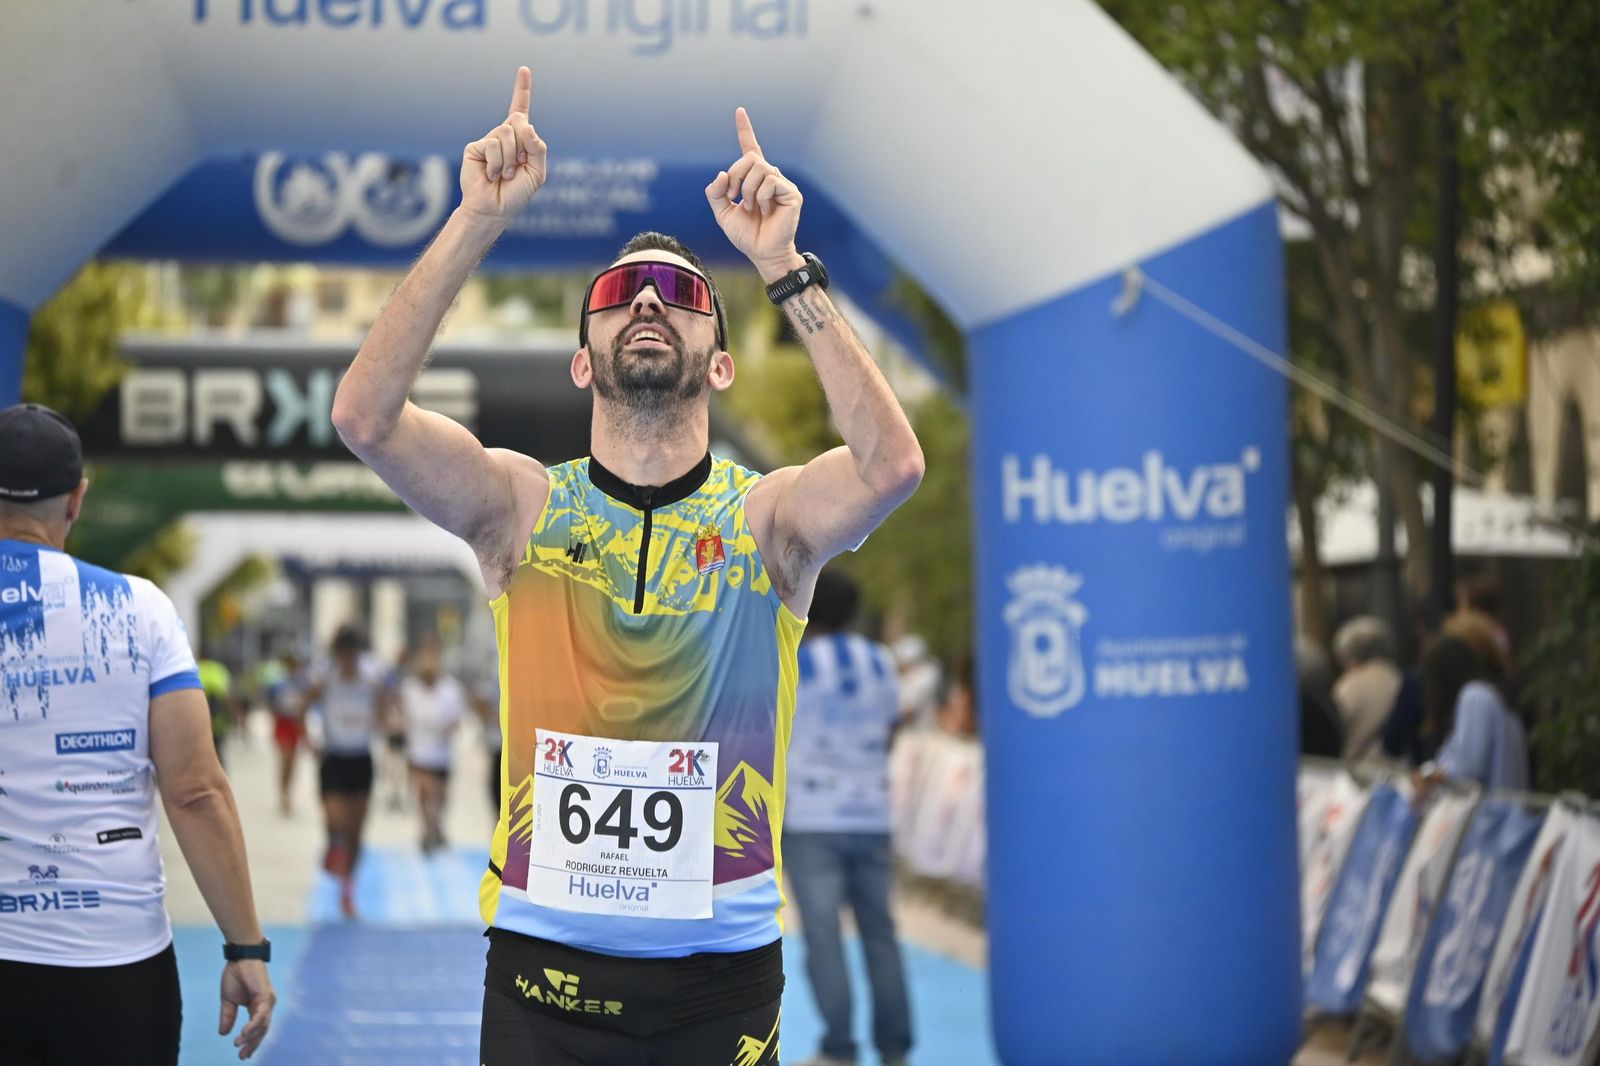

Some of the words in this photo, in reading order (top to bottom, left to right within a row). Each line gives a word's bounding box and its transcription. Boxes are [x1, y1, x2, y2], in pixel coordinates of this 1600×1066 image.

[1002, 450, 1246, 523] Huelva
[0, 580, 65, 604] elva
[6, 667, 96, 689] HUELVA
[1095, 656, 1248, 696] HUELVA
[60, 732, 133, 749] DECATHLON
[543, 764, 574, 778] HUELVA
[613, 769, 648, 779] HUELVA
[668, 749, 704, 777] 21K
[668, 776, 705, 786] HUELVA
[558, 783, 684, 852] 649
[600, 852, 629, 862] RAFAEL
[565, 860, 617, 876] RODRIGUEZ
[619, 867, 668, 879] REVUELTA
[568, 875, 650, 902] Huelva
[619, 903, 649, 912] original
[514, 974, 624, 1016] HANKER
